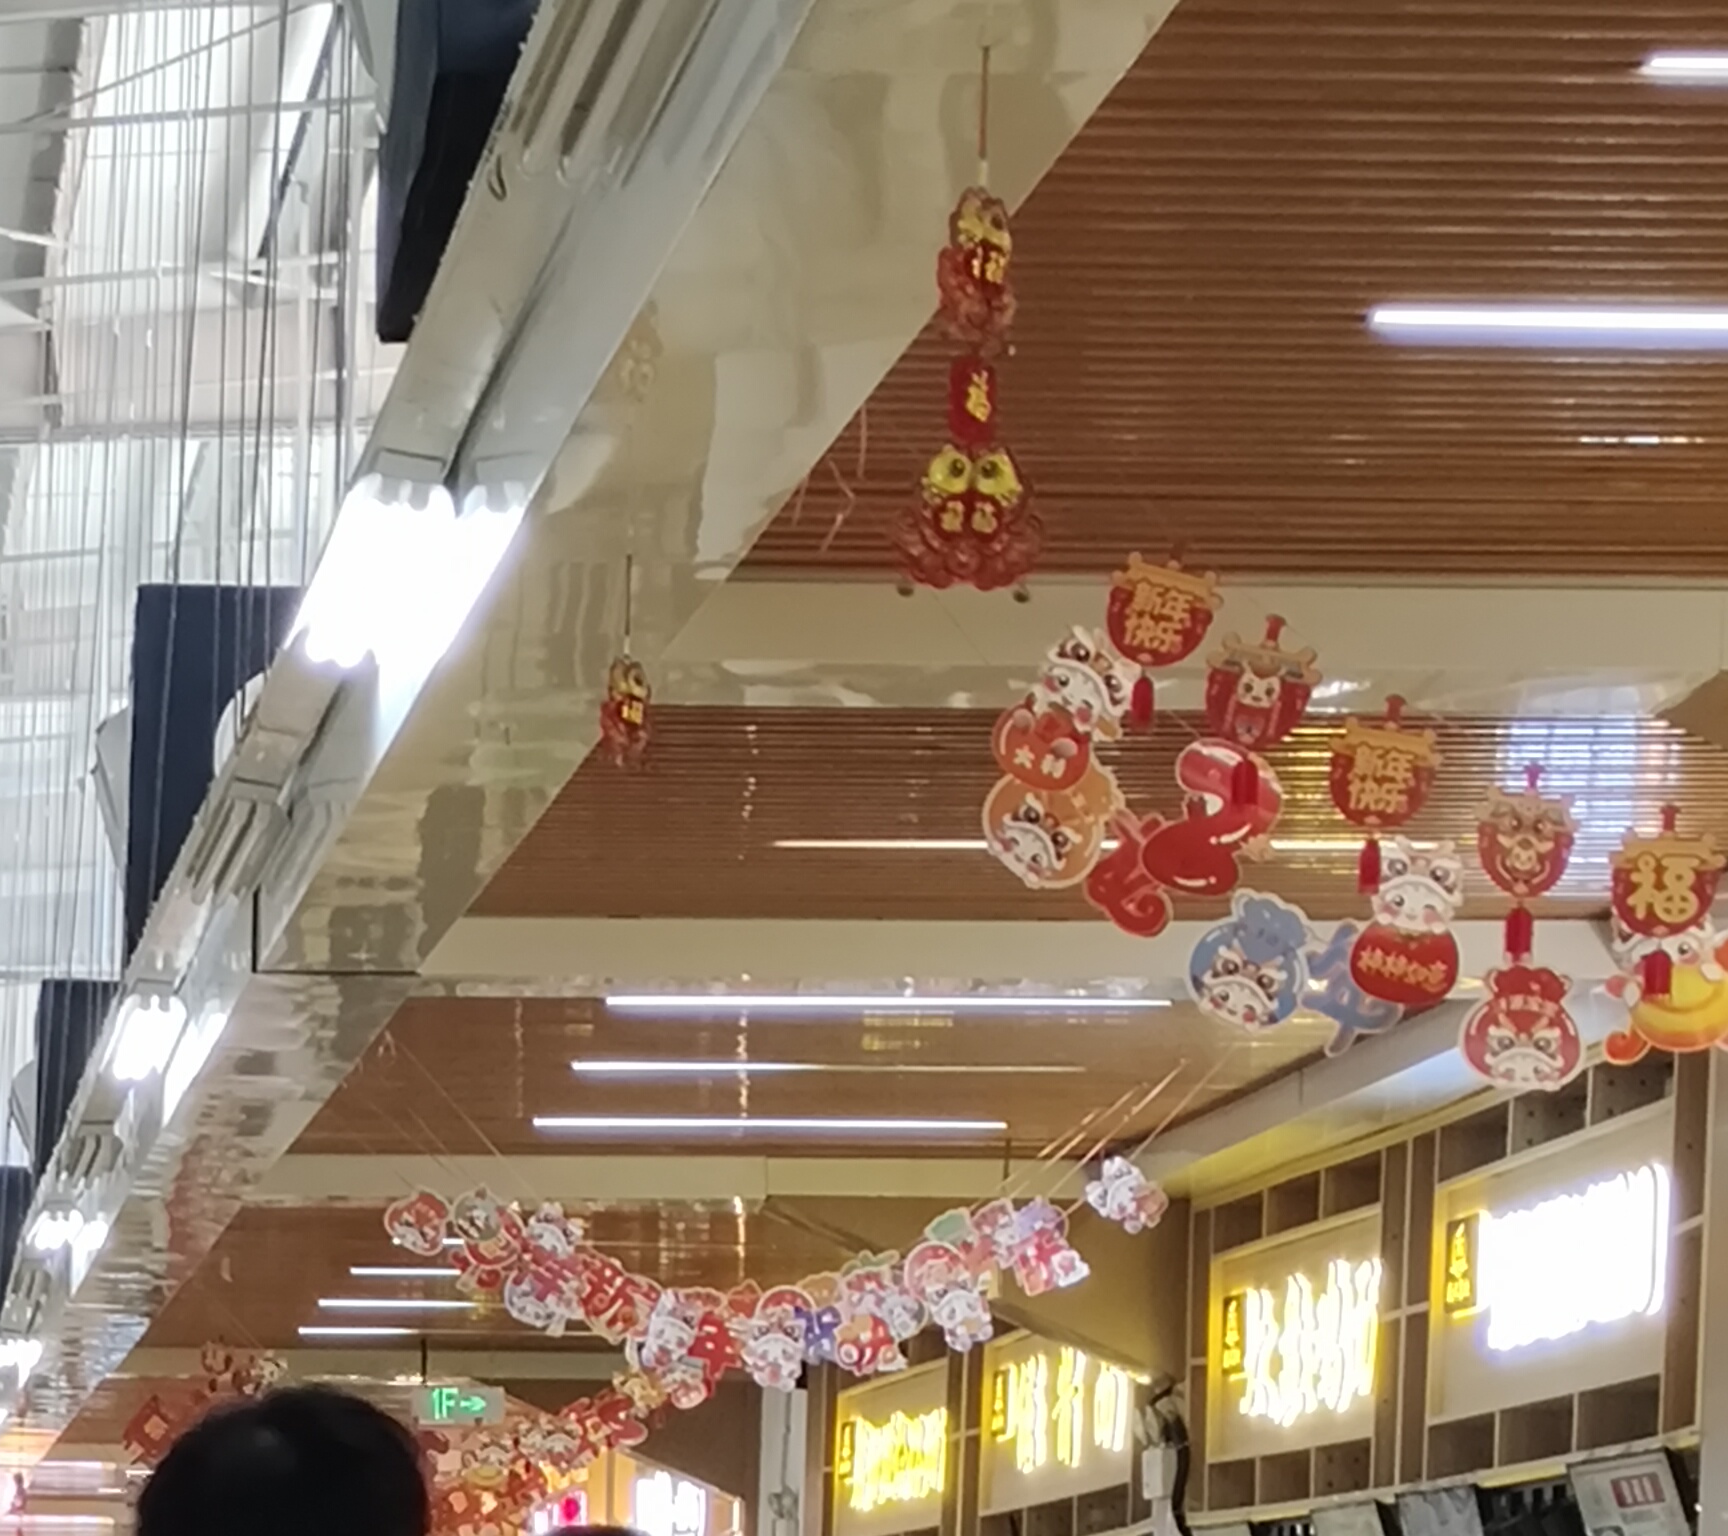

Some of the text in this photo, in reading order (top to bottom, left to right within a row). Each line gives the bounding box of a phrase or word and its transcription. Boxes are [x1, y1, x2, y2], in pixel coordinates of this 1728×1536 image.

[1133, 581, 1194, 628] 新年
[1124, 607, 1183, 654] 快乐
[1353, 745, 1416, 787] 新年
[1347, 773, 1408, 814] 快乐
[1626, 853, 1701, 923] 福
[432, 1387, 459, 1420] 1F
